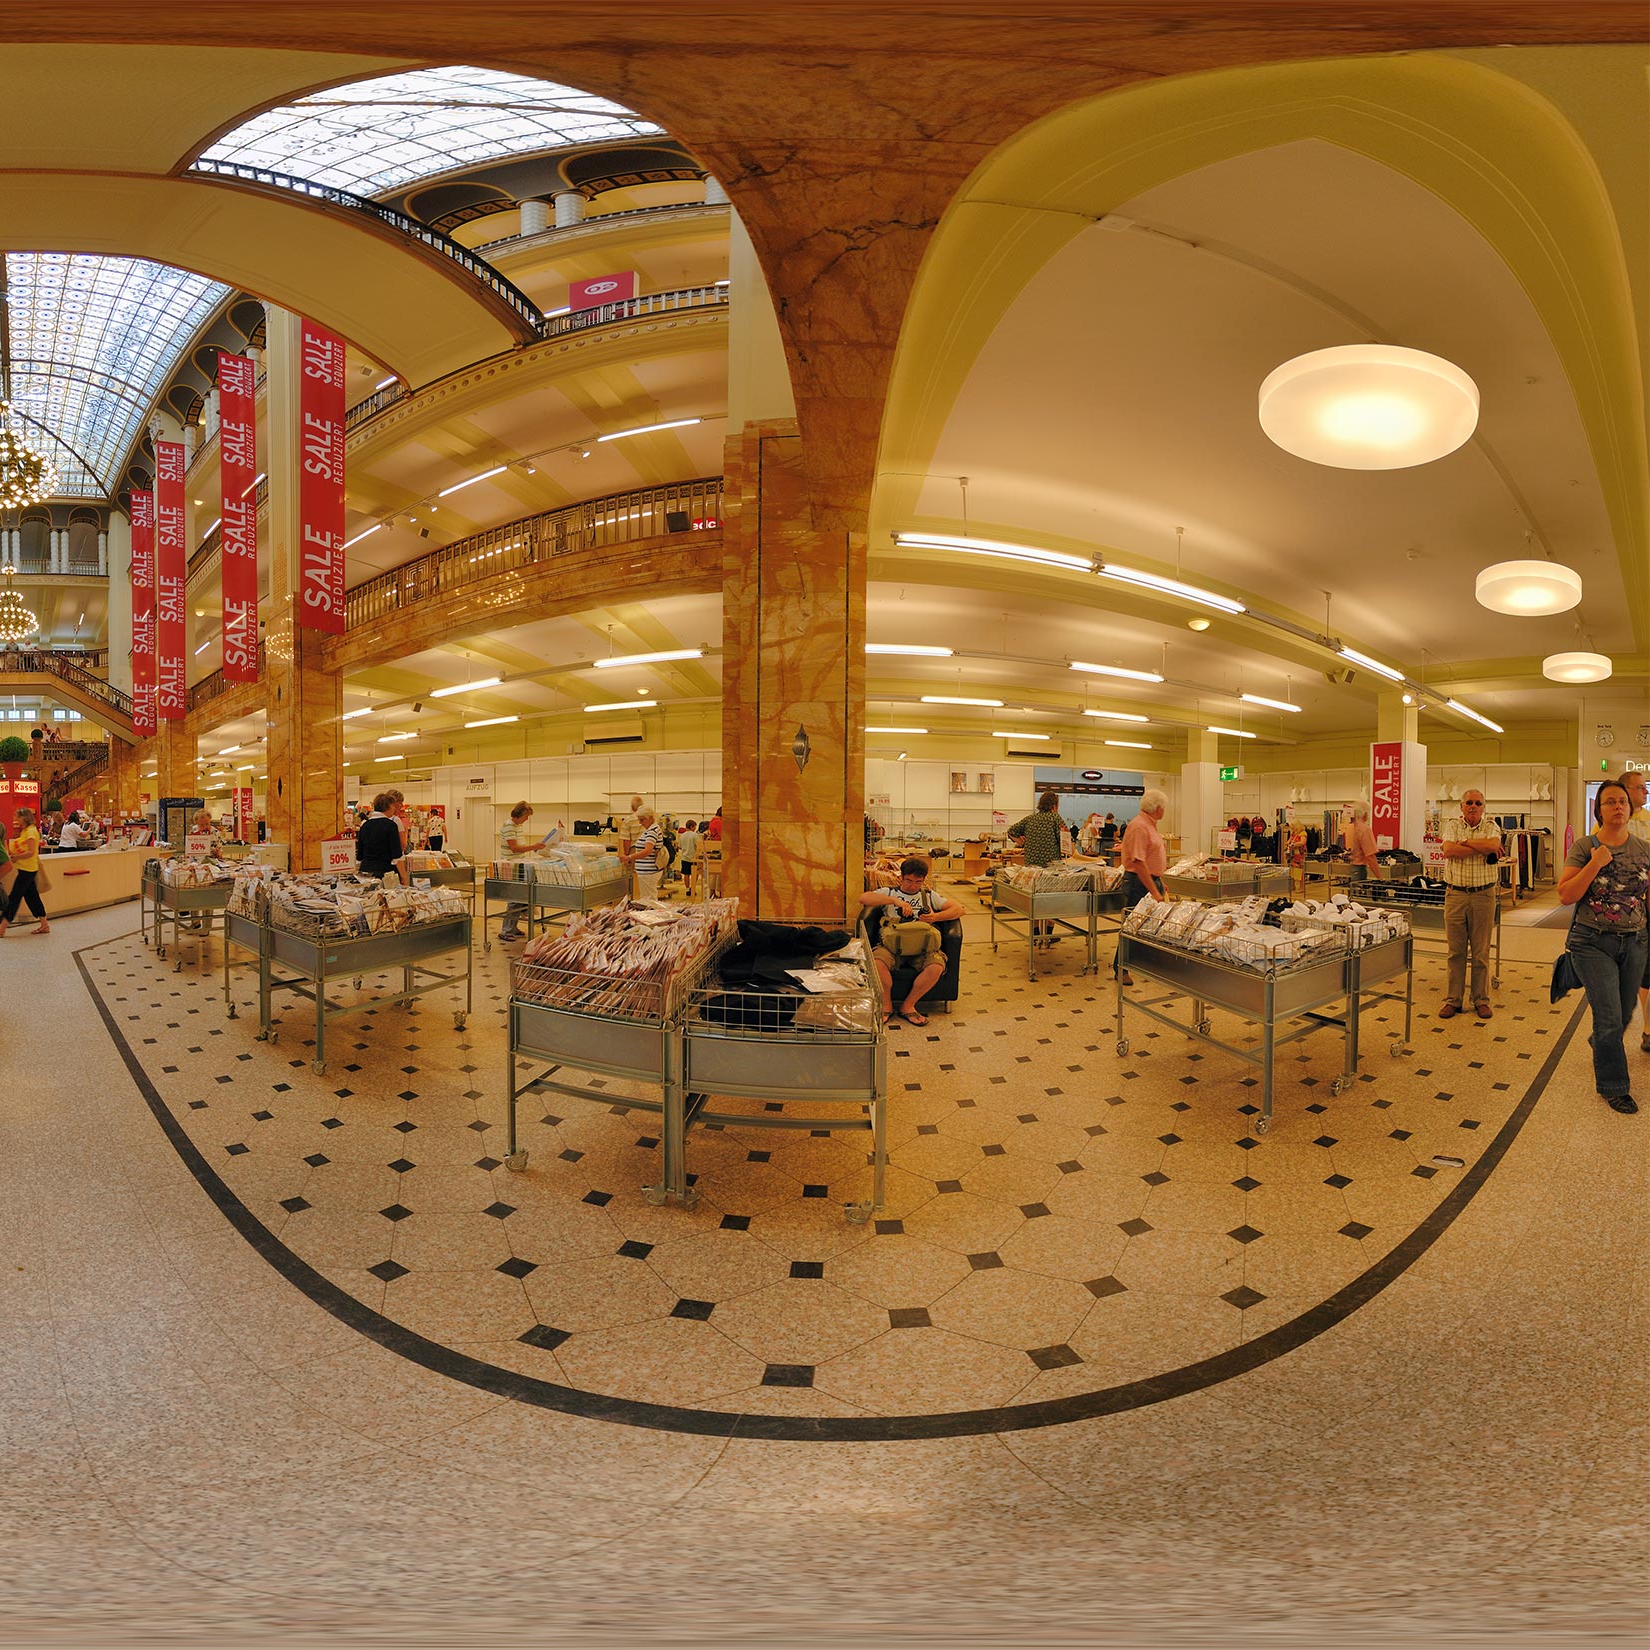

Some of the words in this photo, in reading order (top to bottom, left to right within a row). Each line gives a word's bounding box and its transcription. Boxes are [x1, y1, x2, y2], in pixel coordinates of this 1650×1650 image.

[221, 358, 244, 395] SALE
[245, 362, 253, 399] REDUZIERT
[305, 334, 331, 383] SALE
[334, 343, 342, 387] REDUZIERT
[159, 446, 176, 480] SALE
[223, 419, 245, 466] SALE
[305, 413, 331, 479] SALE
[334, 423, 342, 483] REDUZIERT
[133, 495, 146, 527] SALE
[160, 506, 177, 545] SALE
[225, 498, 246, 556] SALE
[133, 551, 147, 587] SALE
[305, 525, 330, 611] SALE
[334, 534, 343, 614] REDUZIERT
[160, 576, 177, 621] SALE
[134, 613, 148, 654] SALE
[226, 598, 247, 666] SALE
[160, 657, 177, 706] SALE
[134, 684, 148, 726] SALE
[14, 783, 37, 792] Kasse
[1374, 755, 1392, 818] SALE
[1392, 755, 1400, 818] REDUZIERT
[330, 853, 349, 865] 50%
